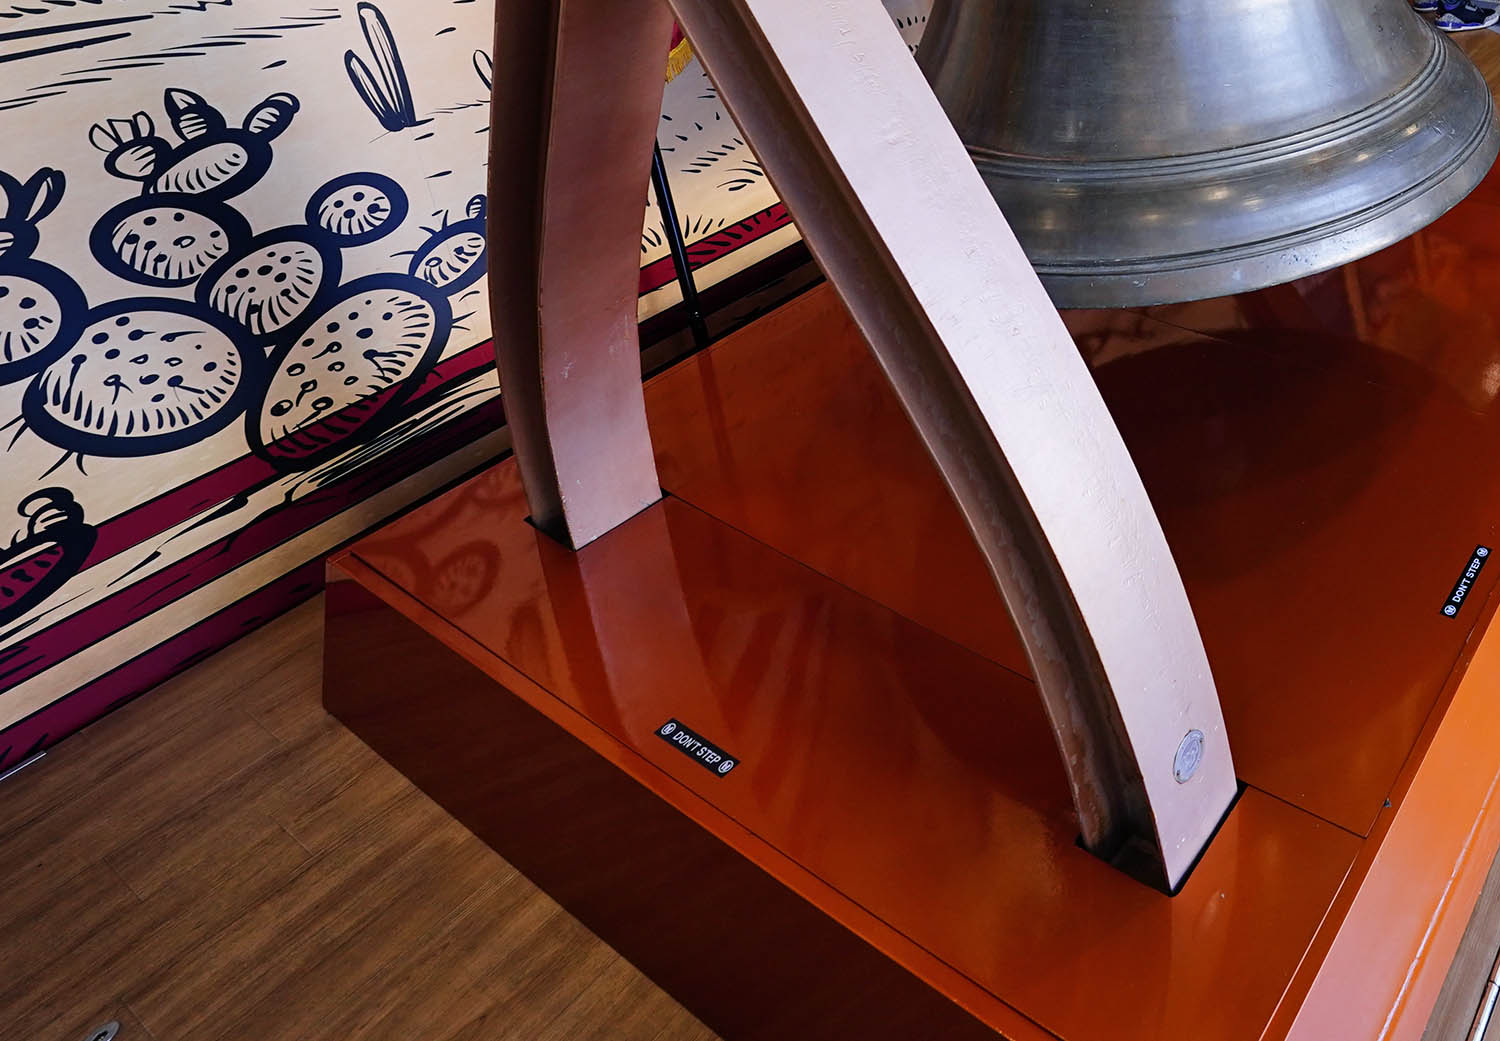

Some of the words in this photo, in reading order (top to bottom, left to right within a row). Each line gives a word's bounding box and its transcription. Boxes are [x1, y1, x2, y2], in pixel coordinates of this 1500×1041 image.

[1452, 577, 1471, 603] DON'T
[1465, 557, 1481, 578] STEP
[672, 730, 702, 752] DON'T
[696, 746, 722, 764] STEP
